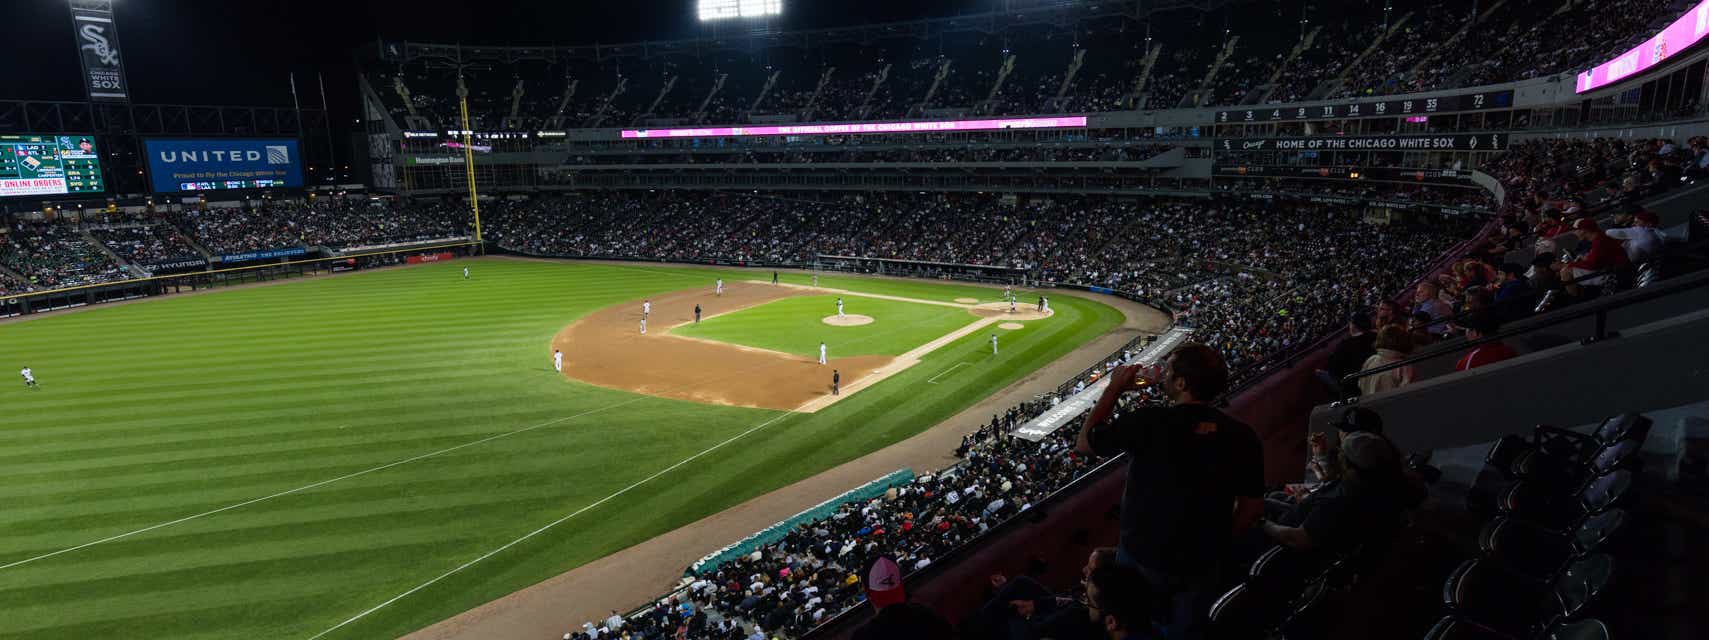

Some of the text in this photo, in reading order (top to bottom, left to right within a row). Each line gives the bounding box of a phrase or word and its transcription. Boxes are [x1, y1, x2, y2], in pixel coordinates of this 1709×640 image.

[92, 81, 121, 89] SOX
[1426, 99, 1437, 109] 35
[1473, 95, 1484, 105] 72
[1350, 105, 1359, 113] 14
[1376, 103, 1385, 112] 16
[1403, 101, 1412, 110] 19
[1273, 109, 1280, 117] 4
[1299, 108, 1305, 116] 9
[1324, 106, 1333, 115] 11
[792, 125, 823, 133] OFFICIAL
[1276, 138, 1455, 148] HOME OF THE CHICAGO WHITE SOX
[160, 150, 262, 163] UNITED
[4, 179, 62, 188] ONLINE ORDERS
[161, 259, 206, 269] HYUNDAI
